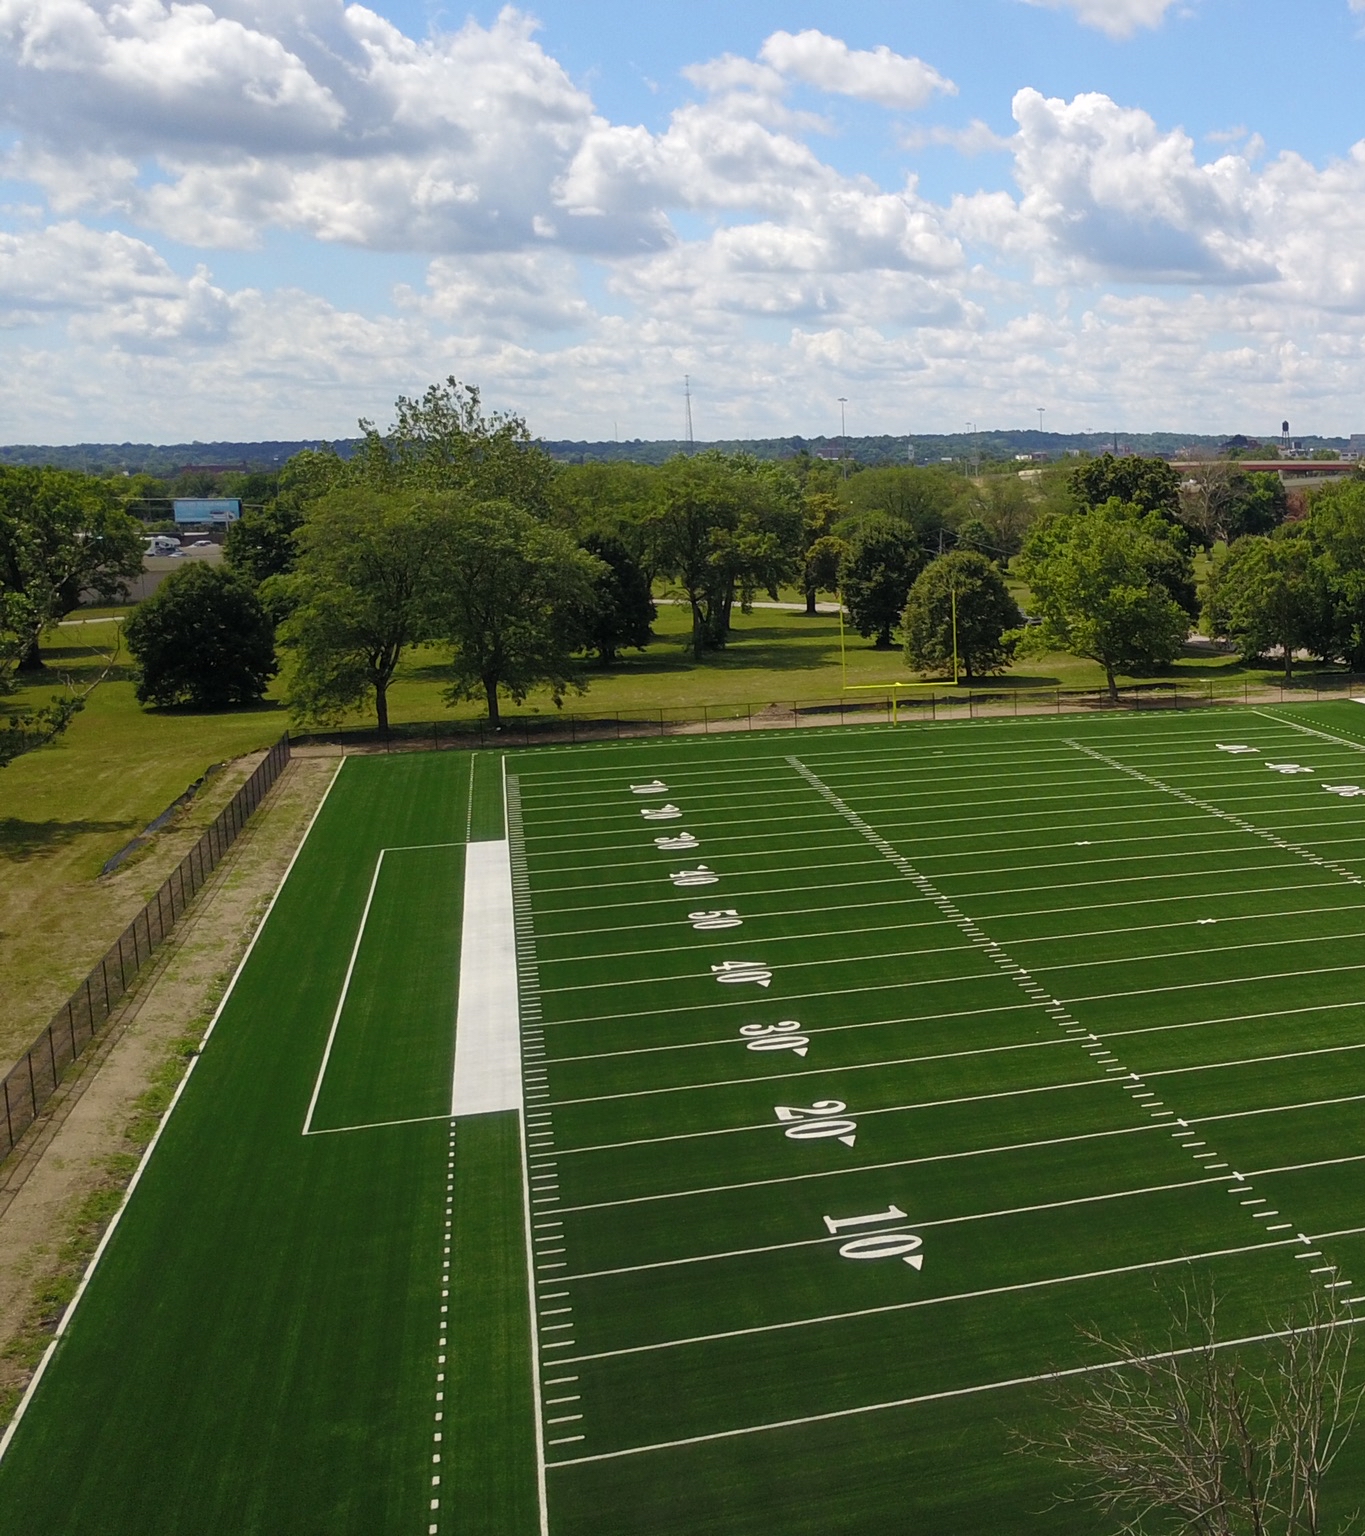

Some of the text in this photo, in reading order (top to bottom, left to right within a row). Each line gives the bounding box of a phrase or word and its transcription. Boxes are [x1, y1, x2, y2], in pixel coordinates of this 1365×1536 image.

[640, 807, 683, 820] 20
[654, 834, 699, 850] 30
[669, 870, 719, 886] 40
[688, 909, 743, 929] 50
[711, 961, 772, 983] 40
[739, 1020, 810, 1050] 30
[774, 1100, 857, 1139] 20
[823, 1205, 923, 1259] 10
